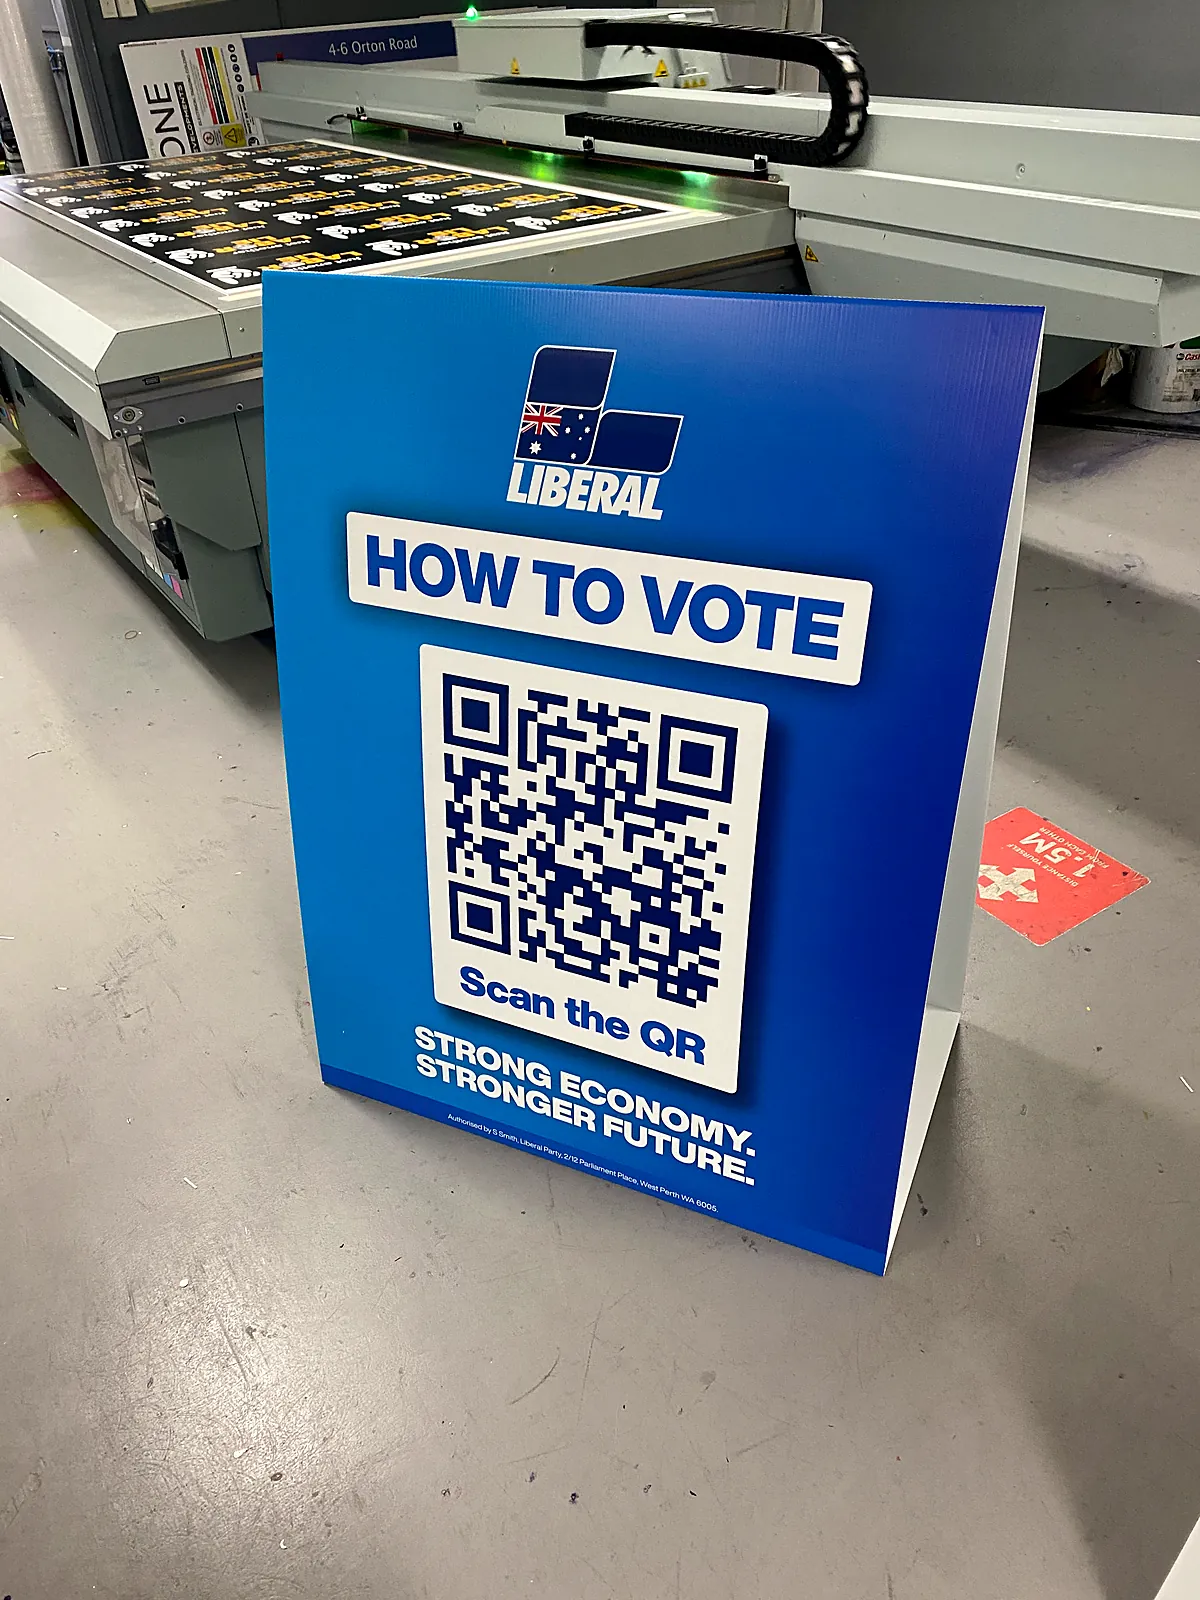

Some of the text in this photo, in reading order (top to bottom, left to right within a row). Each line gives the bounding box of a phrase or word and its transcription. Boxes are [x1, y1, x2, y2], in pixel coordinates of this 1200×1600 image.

[328, 35, 418, 56] 4-6 Orton Road
[177, 84, 199, 153] EVELOPMENTS
[506, 462, 663, 521] LIBERAL
[366, 534, 845, 661] HOW TO VOTE
[1006, 843, 1079, 887] DISTANCE YOURSELF
[1019, 831, 1095, 878] 1.5M
[1039, 826, 1110, 869] FROM EACH OTHER
[459, 965, 706, 1066] Scan the QR
[414, 1025, 756, 1157] STRONG ECONOMY.
[415, 1053, 756, 1186] STRONGER FUTURE.
[447, 1113, 719, 1213] Authorised by S Smith, Liberal Party, 2/12 Parliament Place, West Perth WA 6005.
